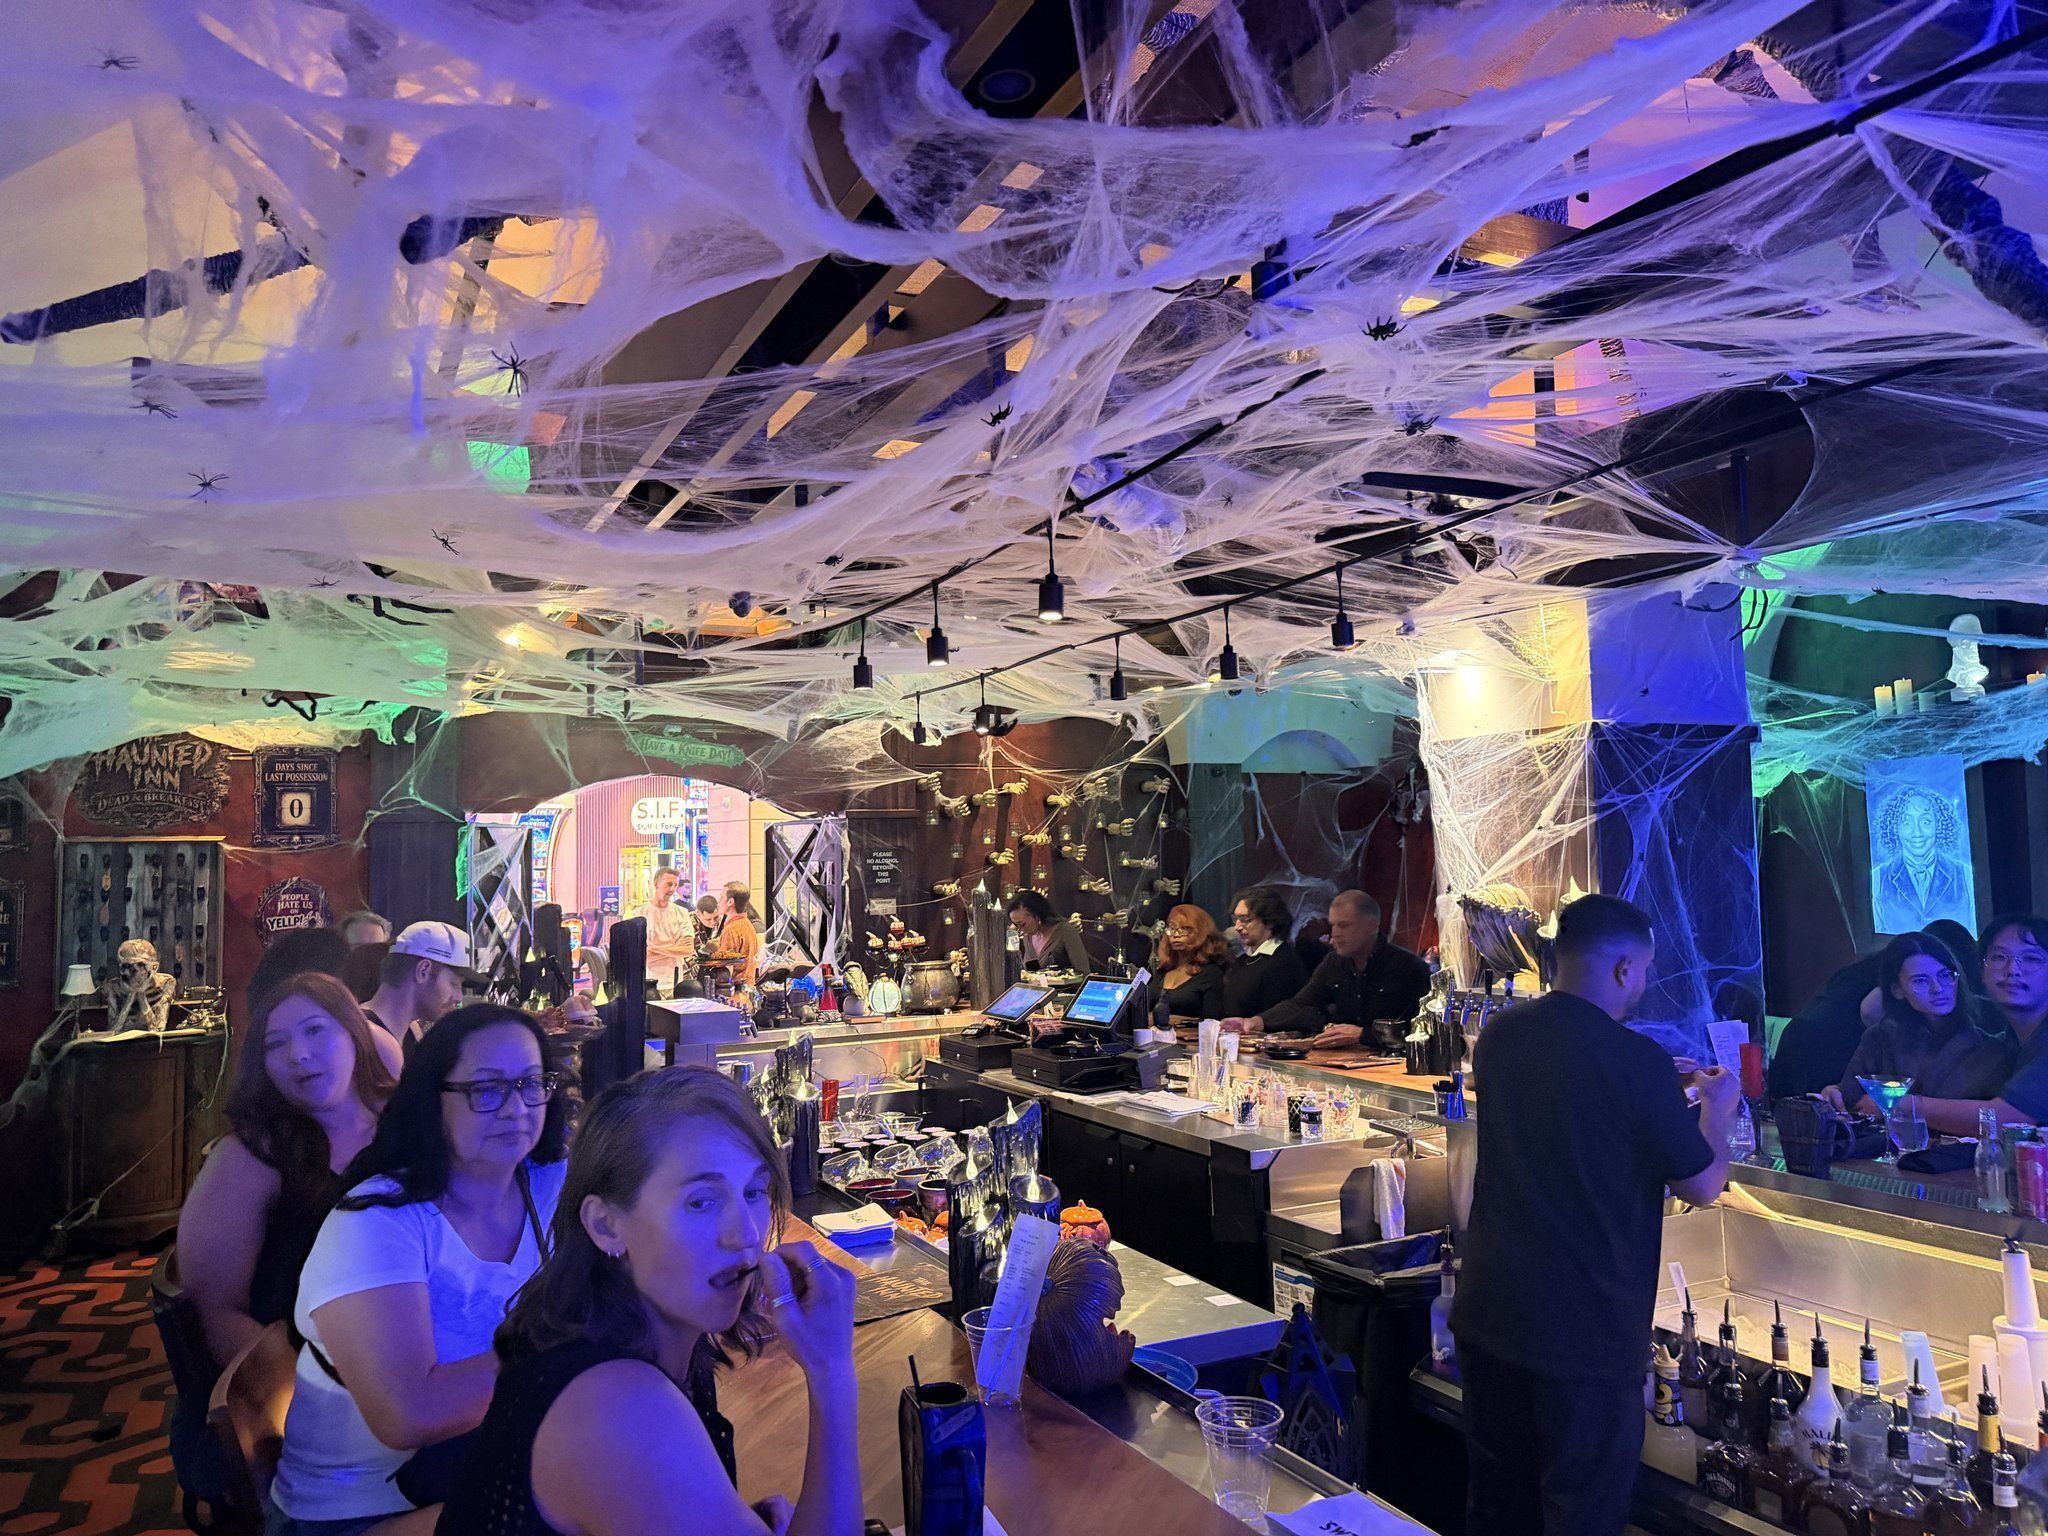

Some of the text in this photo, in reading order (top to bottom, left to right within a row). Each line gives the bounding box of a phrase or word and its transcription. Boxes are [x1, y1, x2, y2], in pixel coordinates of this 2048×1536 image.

[640, 739, 732, 762] HAVE A KNIFE DAY!
[90, 740, 213, 781] HAUNTED
[275, 763, 319, 772] DAYS SINCE
[133, 766, 181, 793] INN
[265, 773, 328, 782] LAST POSSESSION
[97, 793, 129, 812] DEAD
[289, 798, 304, 819] 0
[637, 801, 684, 819] S.I.F.
[277, 900, 314, 911] HATE US
[281, 893, 310, 901] PEOPLE
[1801, 1428, 1832, 1440] MALI
